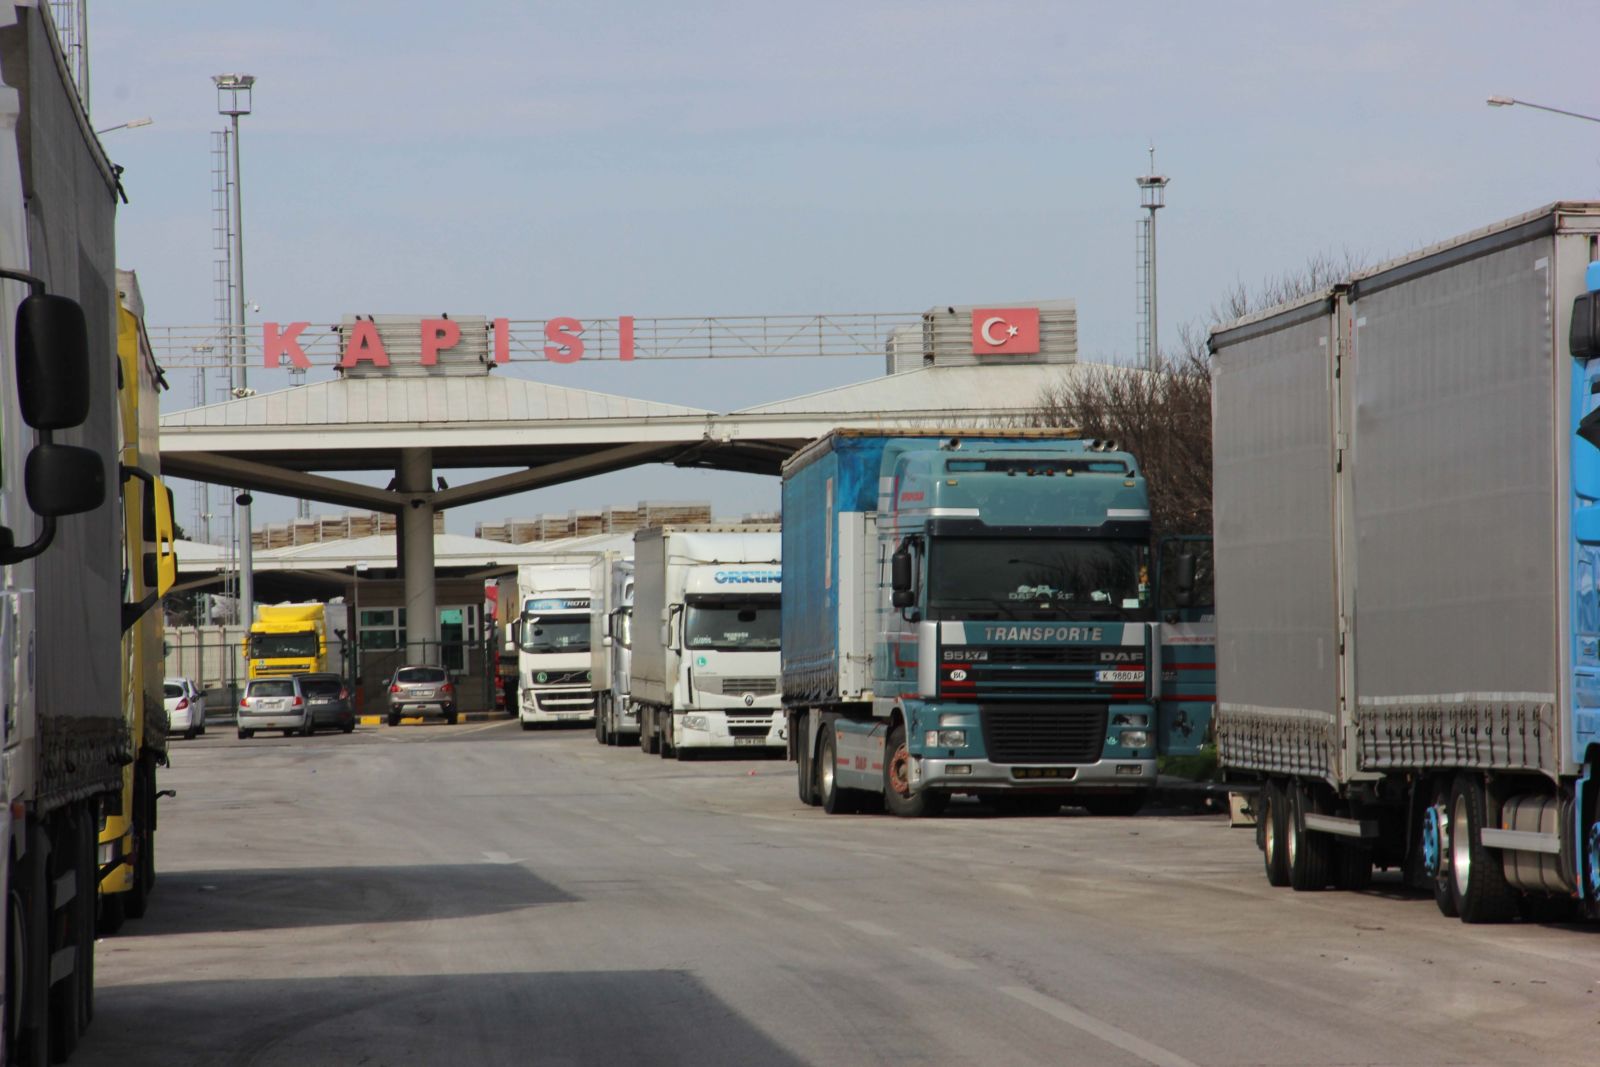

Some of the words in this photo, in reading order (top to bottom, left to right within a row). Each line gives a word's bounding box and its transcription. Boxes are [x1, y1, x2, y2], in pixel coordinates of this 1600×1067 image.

[263, 316, 635, 369] KAPISI
[985, 627, 1102, 641] TRANSPORTE
[1100, 652, 1144, 661] DAF
[953, 670, 964, 680] BG
